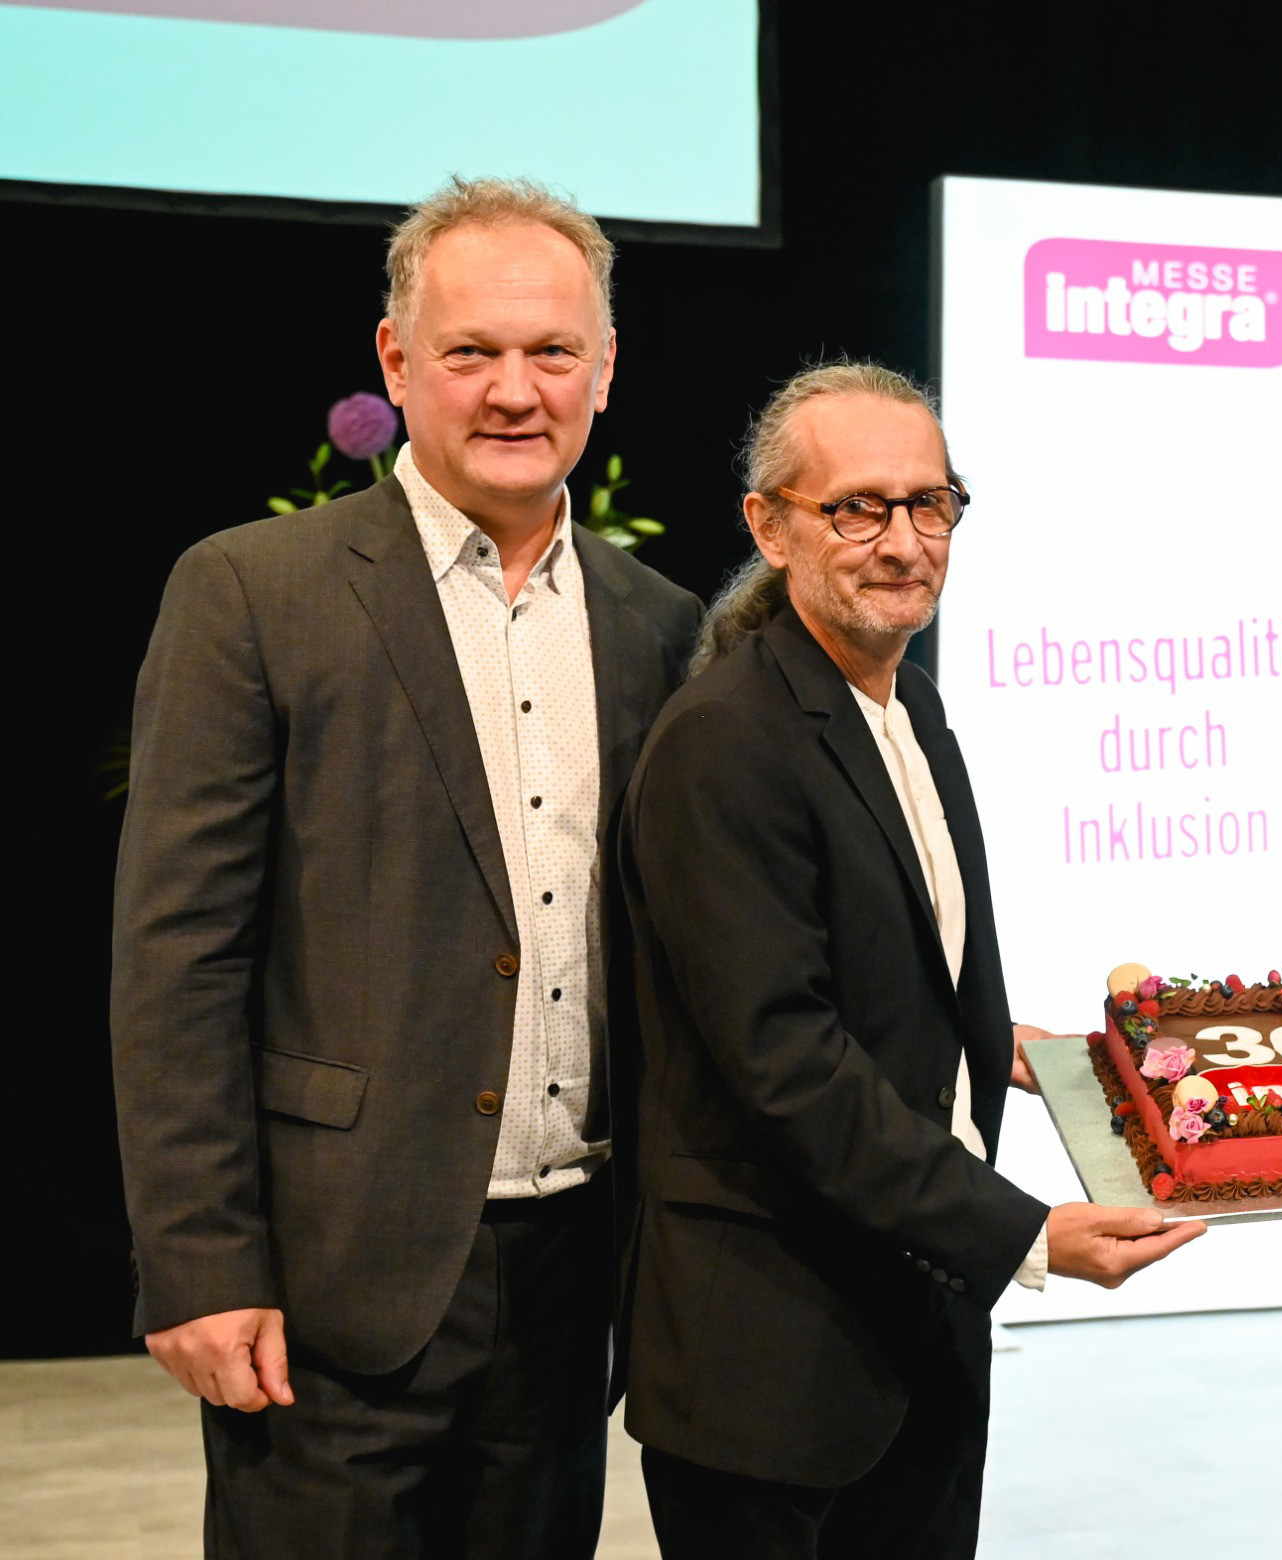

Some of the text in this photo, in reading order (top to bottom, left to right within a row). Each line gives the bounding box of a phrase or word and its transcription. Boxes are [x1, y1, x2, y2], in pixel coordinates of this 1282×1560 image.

[1131, 258, 1259, 293] MESSE
[1045, 271, 1268, 353] integra
[1099, 709, 1227, 773] durch
[1063, 796, 1268, 865] Inklusion
